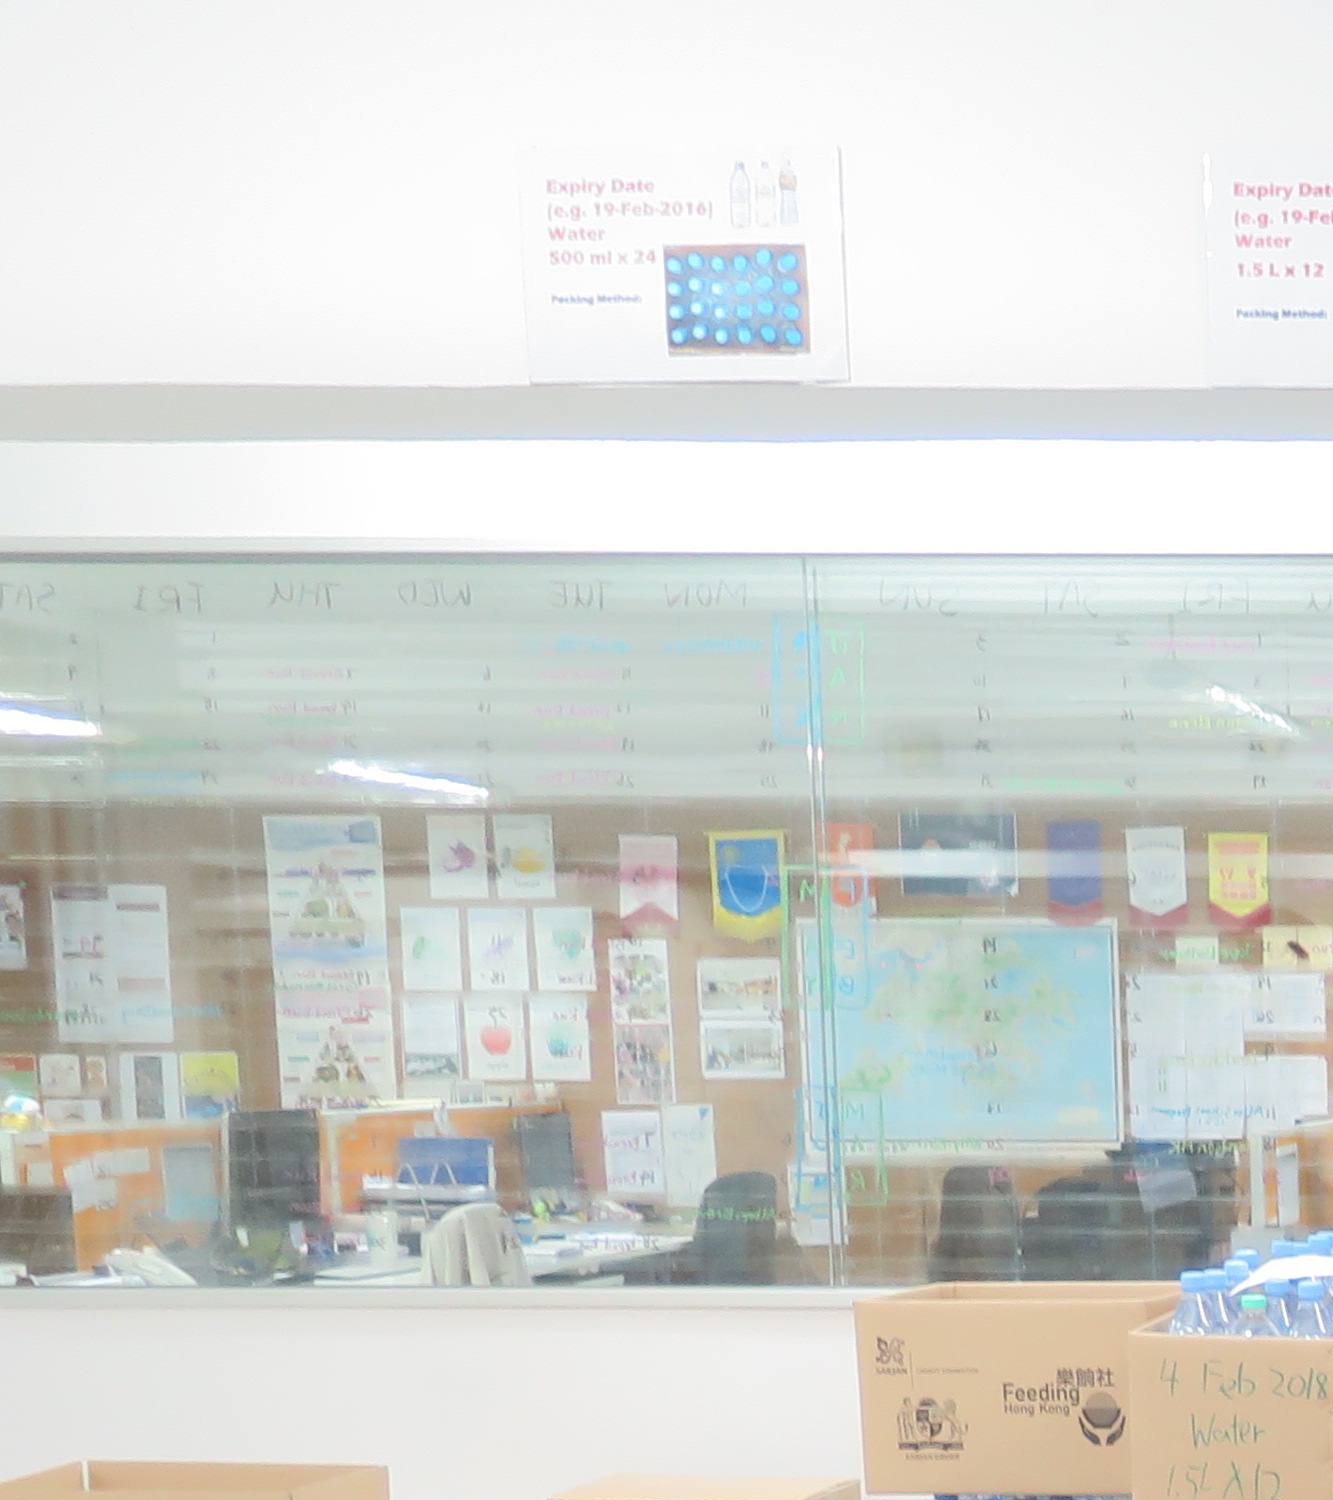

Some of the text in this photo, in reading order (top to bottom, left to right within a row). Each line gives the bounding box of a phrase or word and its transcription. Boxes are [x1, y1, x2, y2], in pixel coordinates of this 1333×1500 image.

[546, 178, 655, 197] Expiry Date
[1233, 182, 1293, 201] Expiry
[547, 201, 713, 221] (e.g. 19-Feb-2016)
[1234, 210, 1274, 228] (e.g.
[548, 226, 606, 241] Water
[1235, 234, 1292, 248] Water
[550, 250, 656, 265] 500 ml x 24
[1237, 263, 1324, 277] 1.5 L x 12
[1160, 1357, 1330, 1401] 4 Feb 2018
[1002, 1382, 1080, 1406] Feeding
[1004, 1403, 1070, 1417] Hong Kong
[1190, 1412, 1267, 1448] Water
